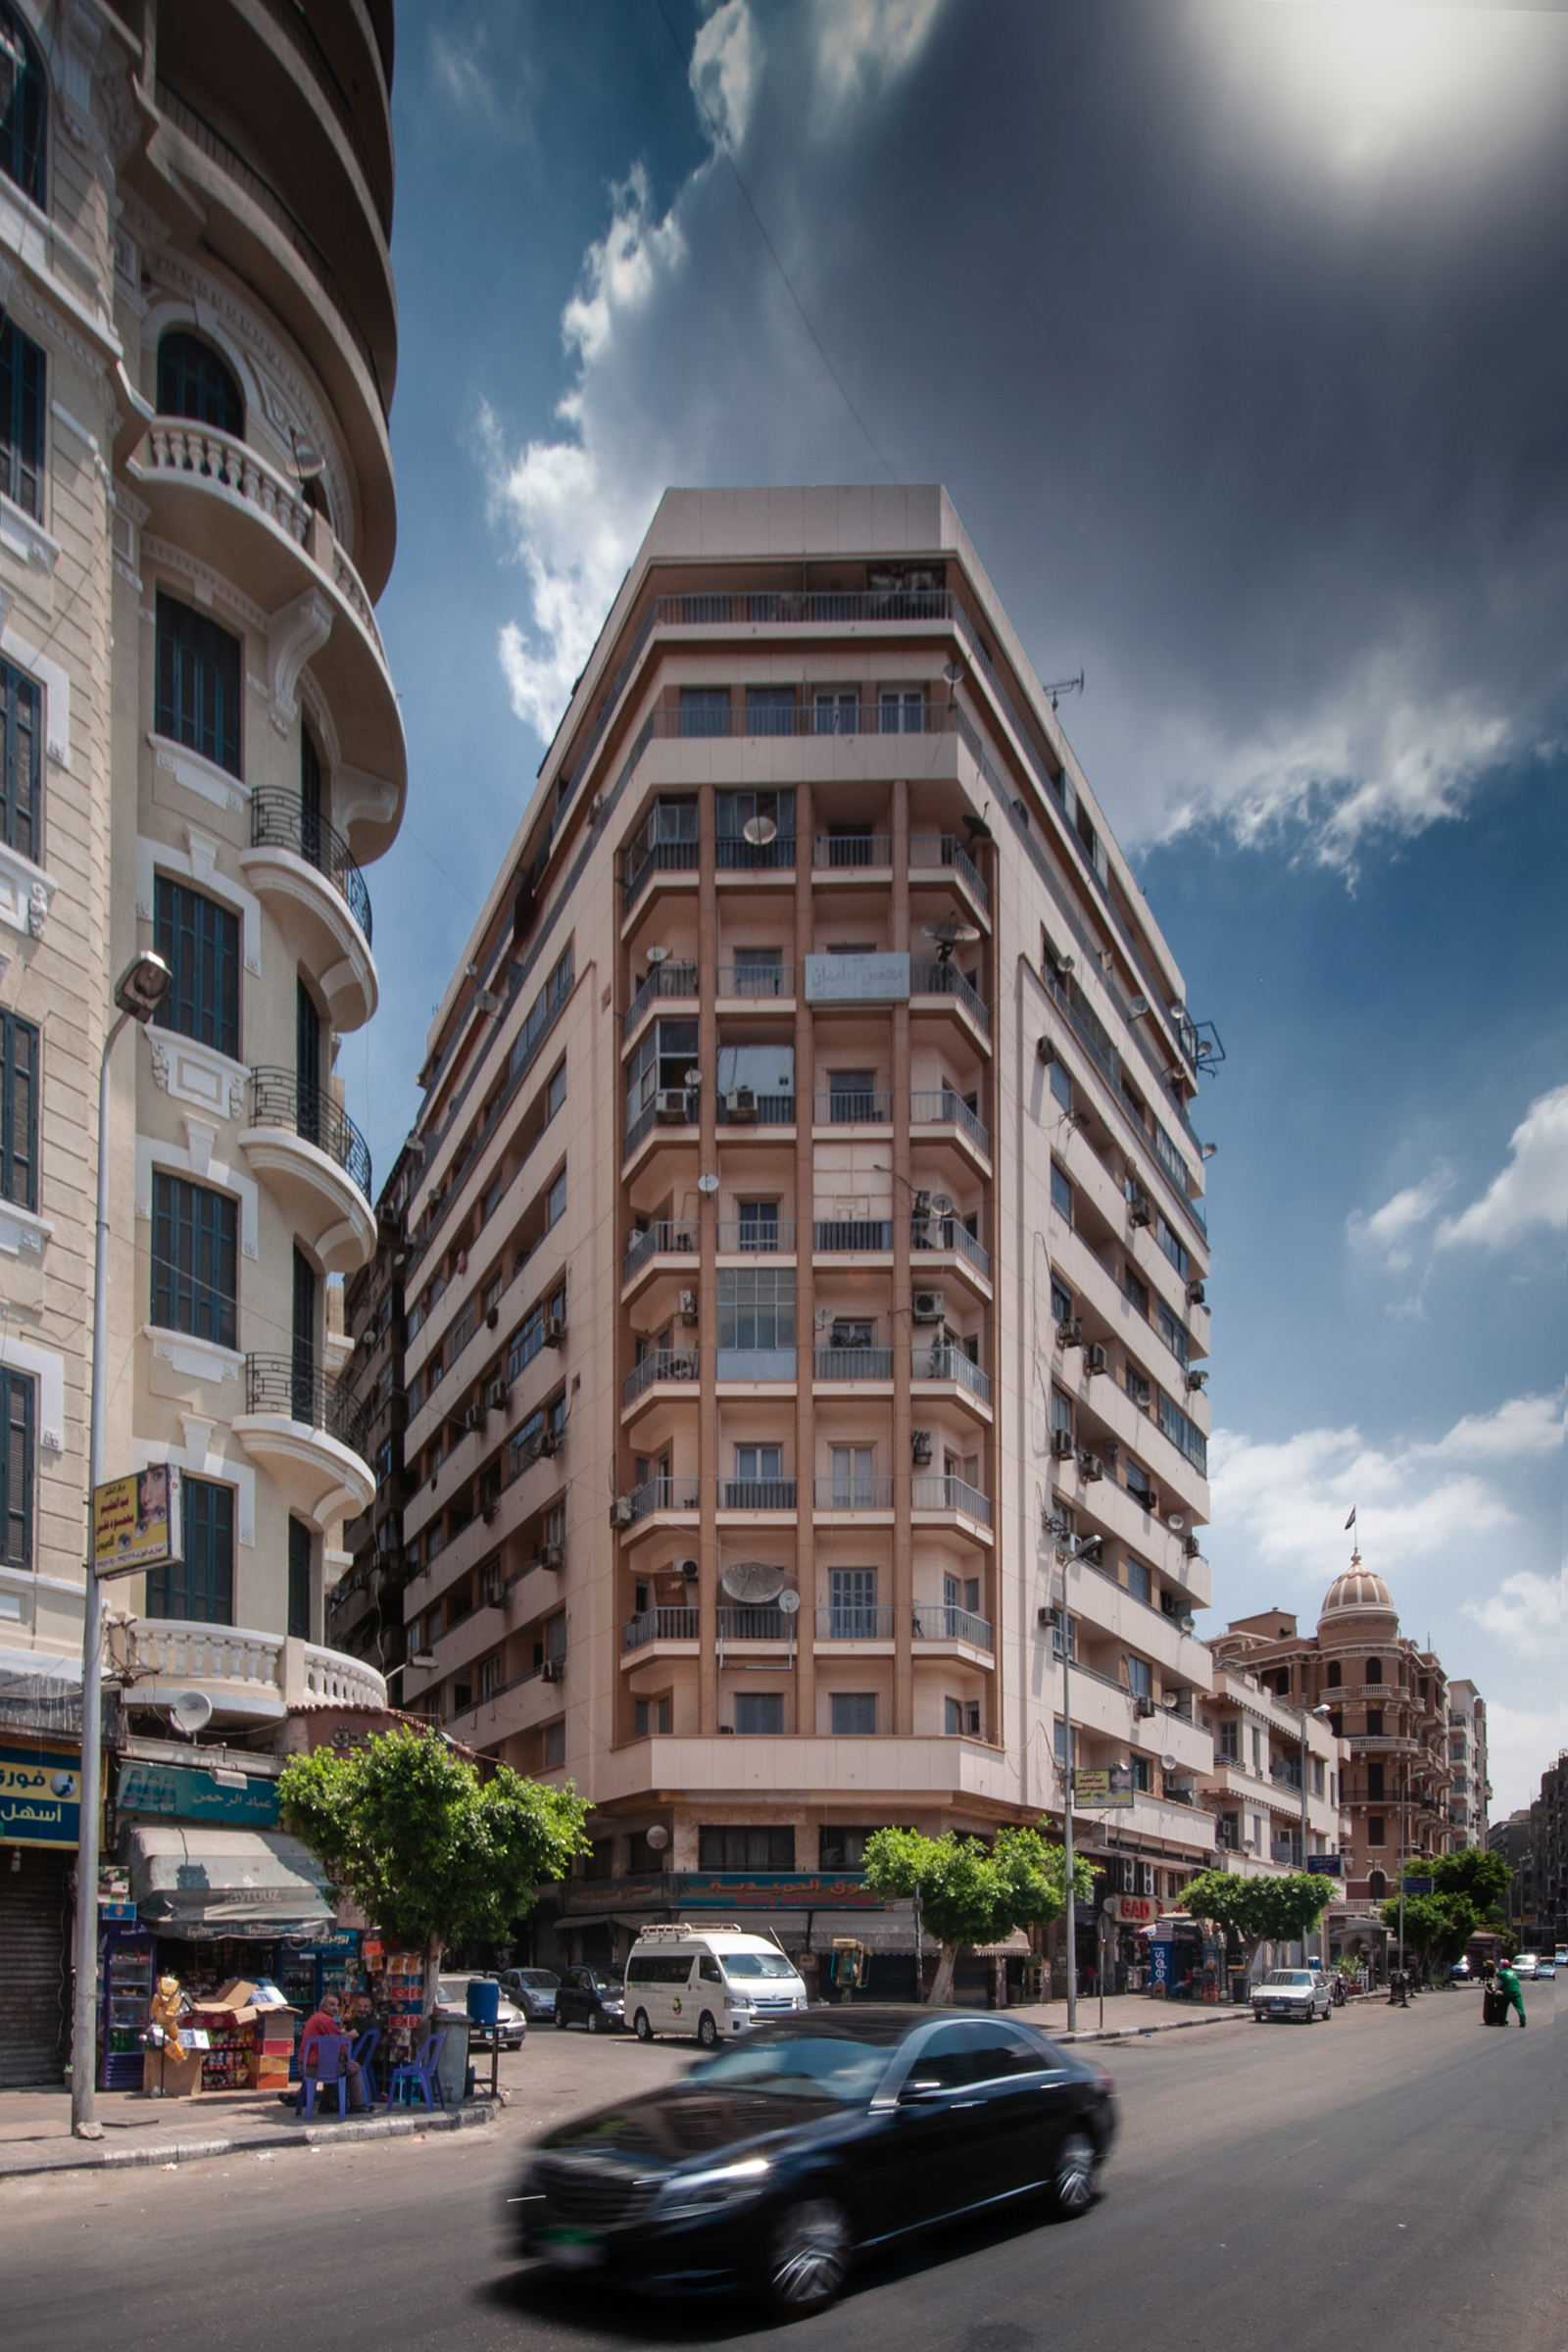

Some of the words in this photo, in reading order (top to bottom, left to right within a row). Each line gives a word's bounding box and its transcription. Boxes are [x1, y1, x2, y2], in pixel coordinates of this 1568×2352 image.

[192, 1790, 242, 1807] الرحمن
[1, 1803, 61, 1822] أسهل
[710, 1878, 821, 1896] الحميدية
[1121, 1899, 1151, 1919] GAD
[312, 1935, 350, 1944] PEPSI
[1153, 1947, 1167, 1984] epsi
